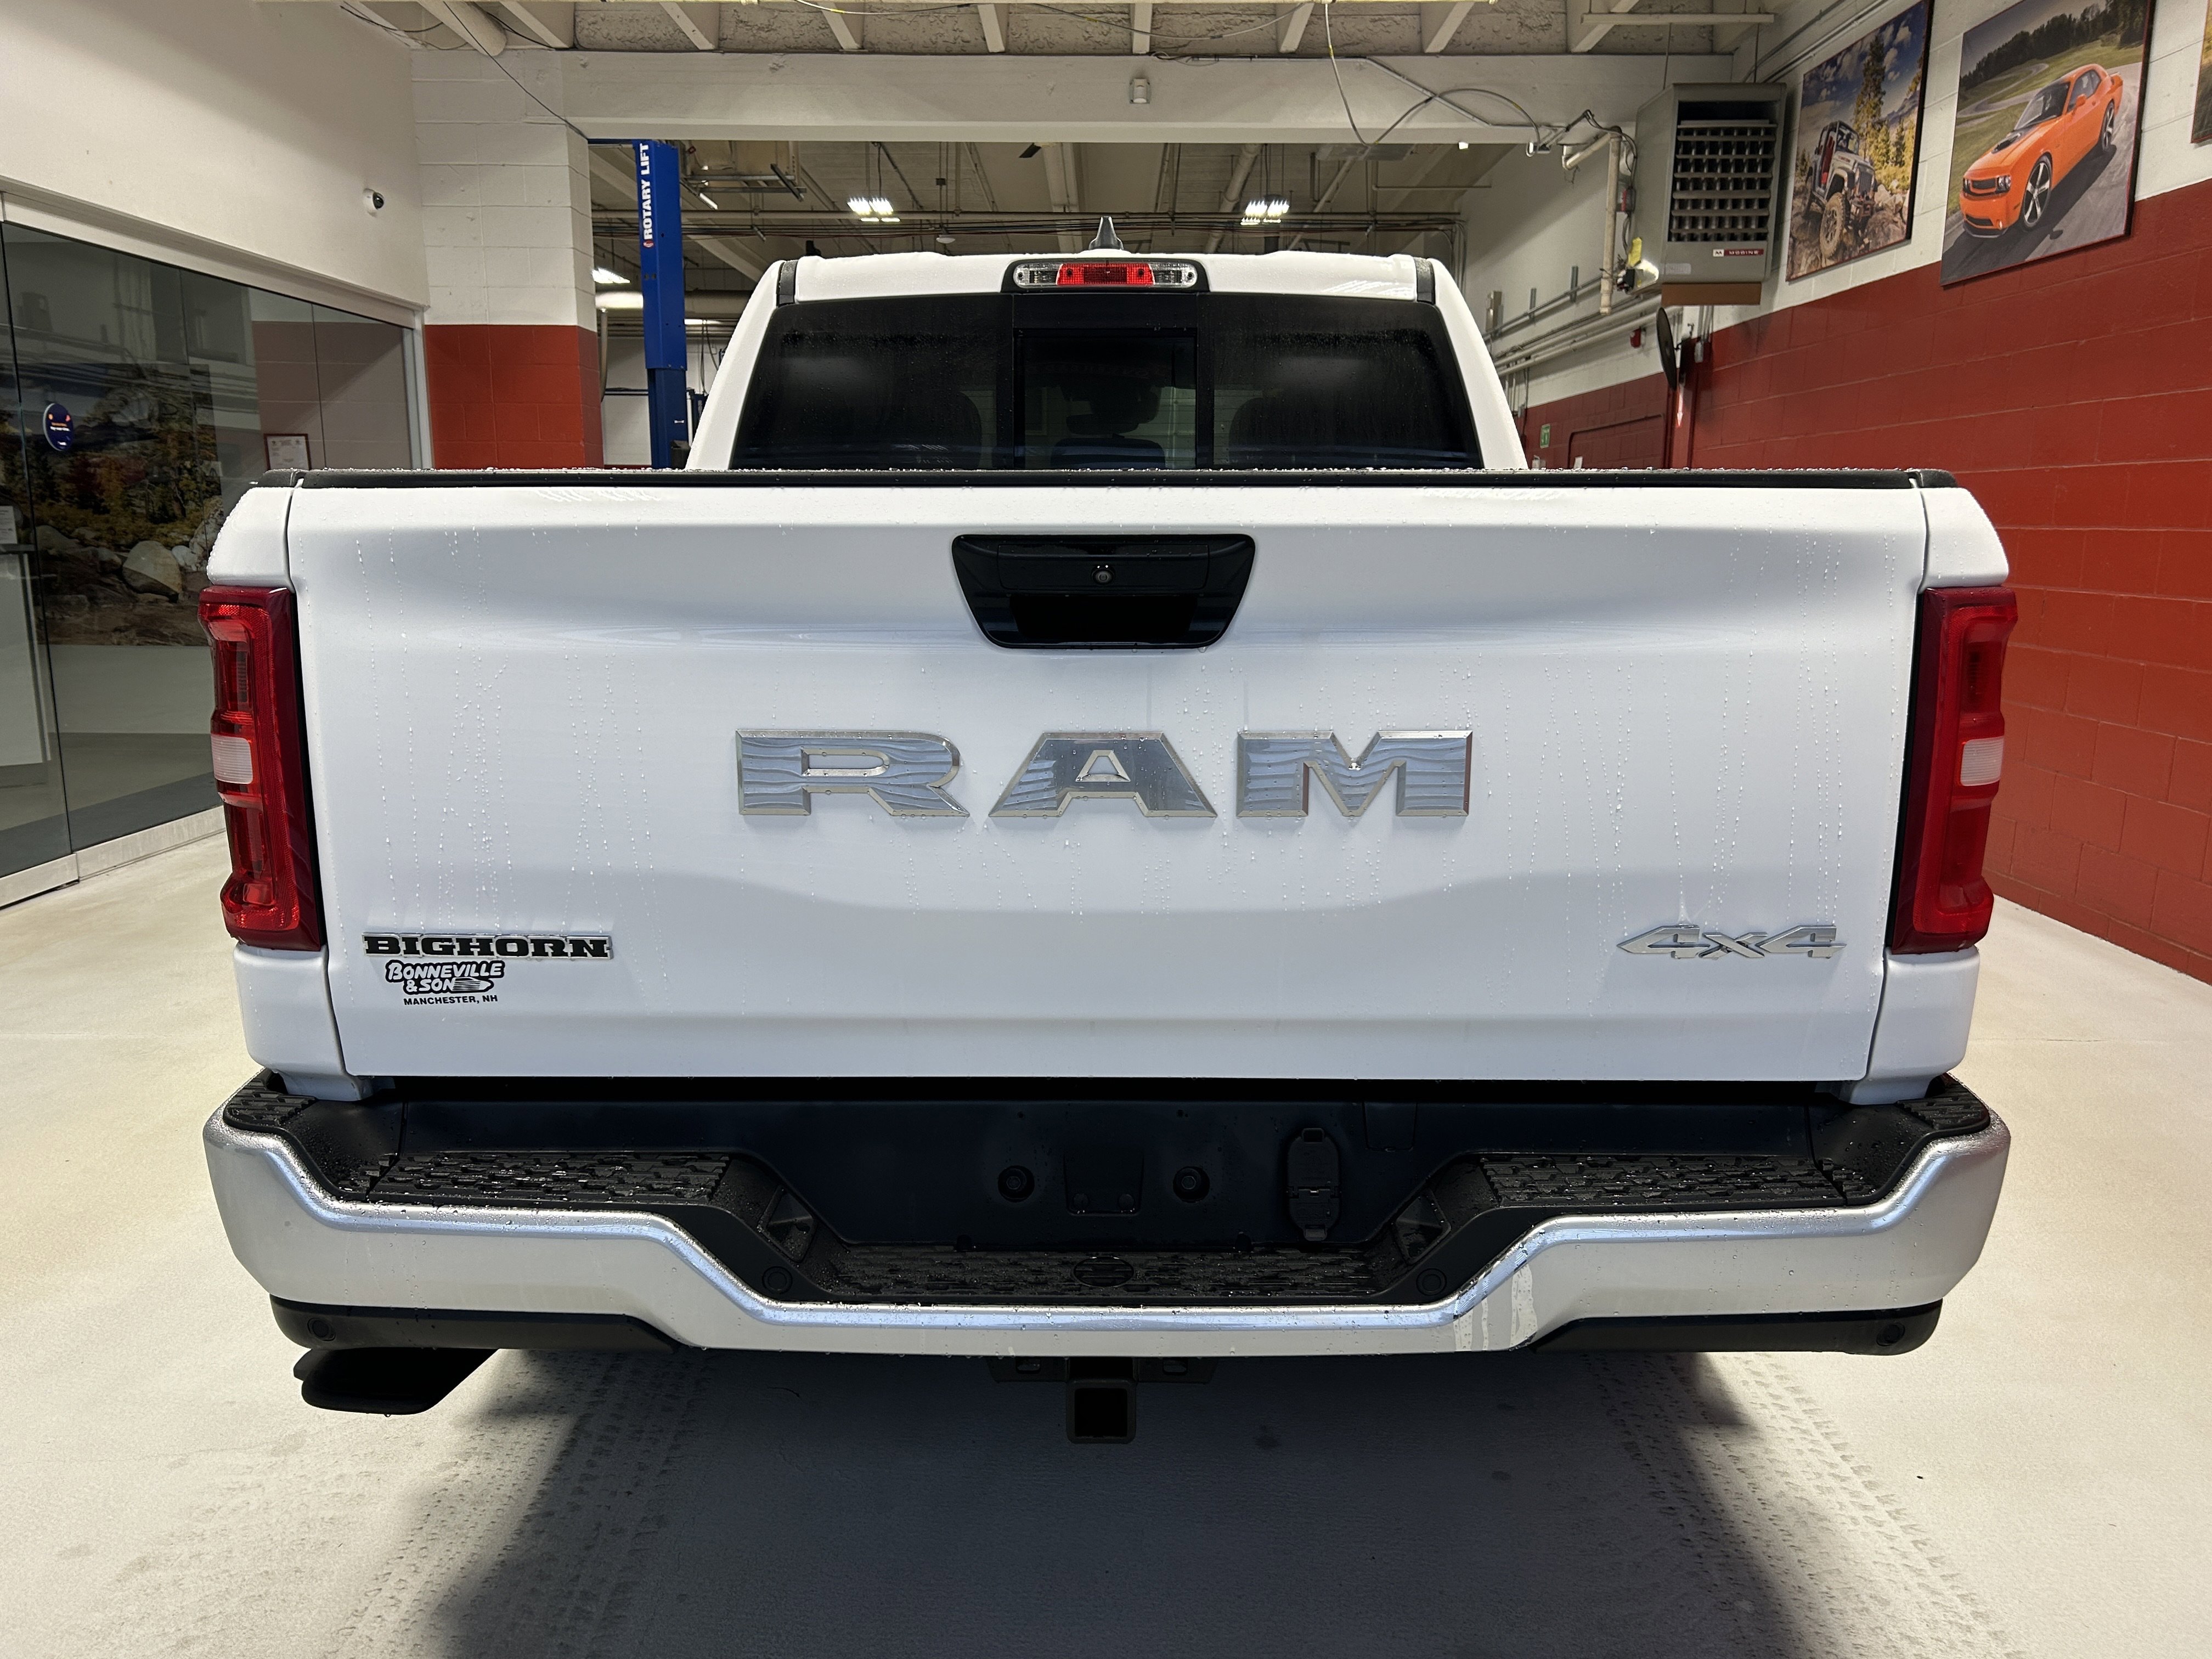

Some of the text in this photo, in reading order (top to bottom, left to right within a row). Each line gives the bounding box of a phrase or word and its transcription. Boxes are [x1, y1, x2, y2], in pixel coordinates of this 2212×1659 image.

[640, 143, 650, 175] LIFT
[642, 179, 653, 240] ROTARY
[736, 729, 1474, 817] RAM
[362, 932, 614, 960] BIGHORN
[387, 962, 503, 980] BONNEVILLE
[403, 995, 498, 1006] MANCHESTER, NH
